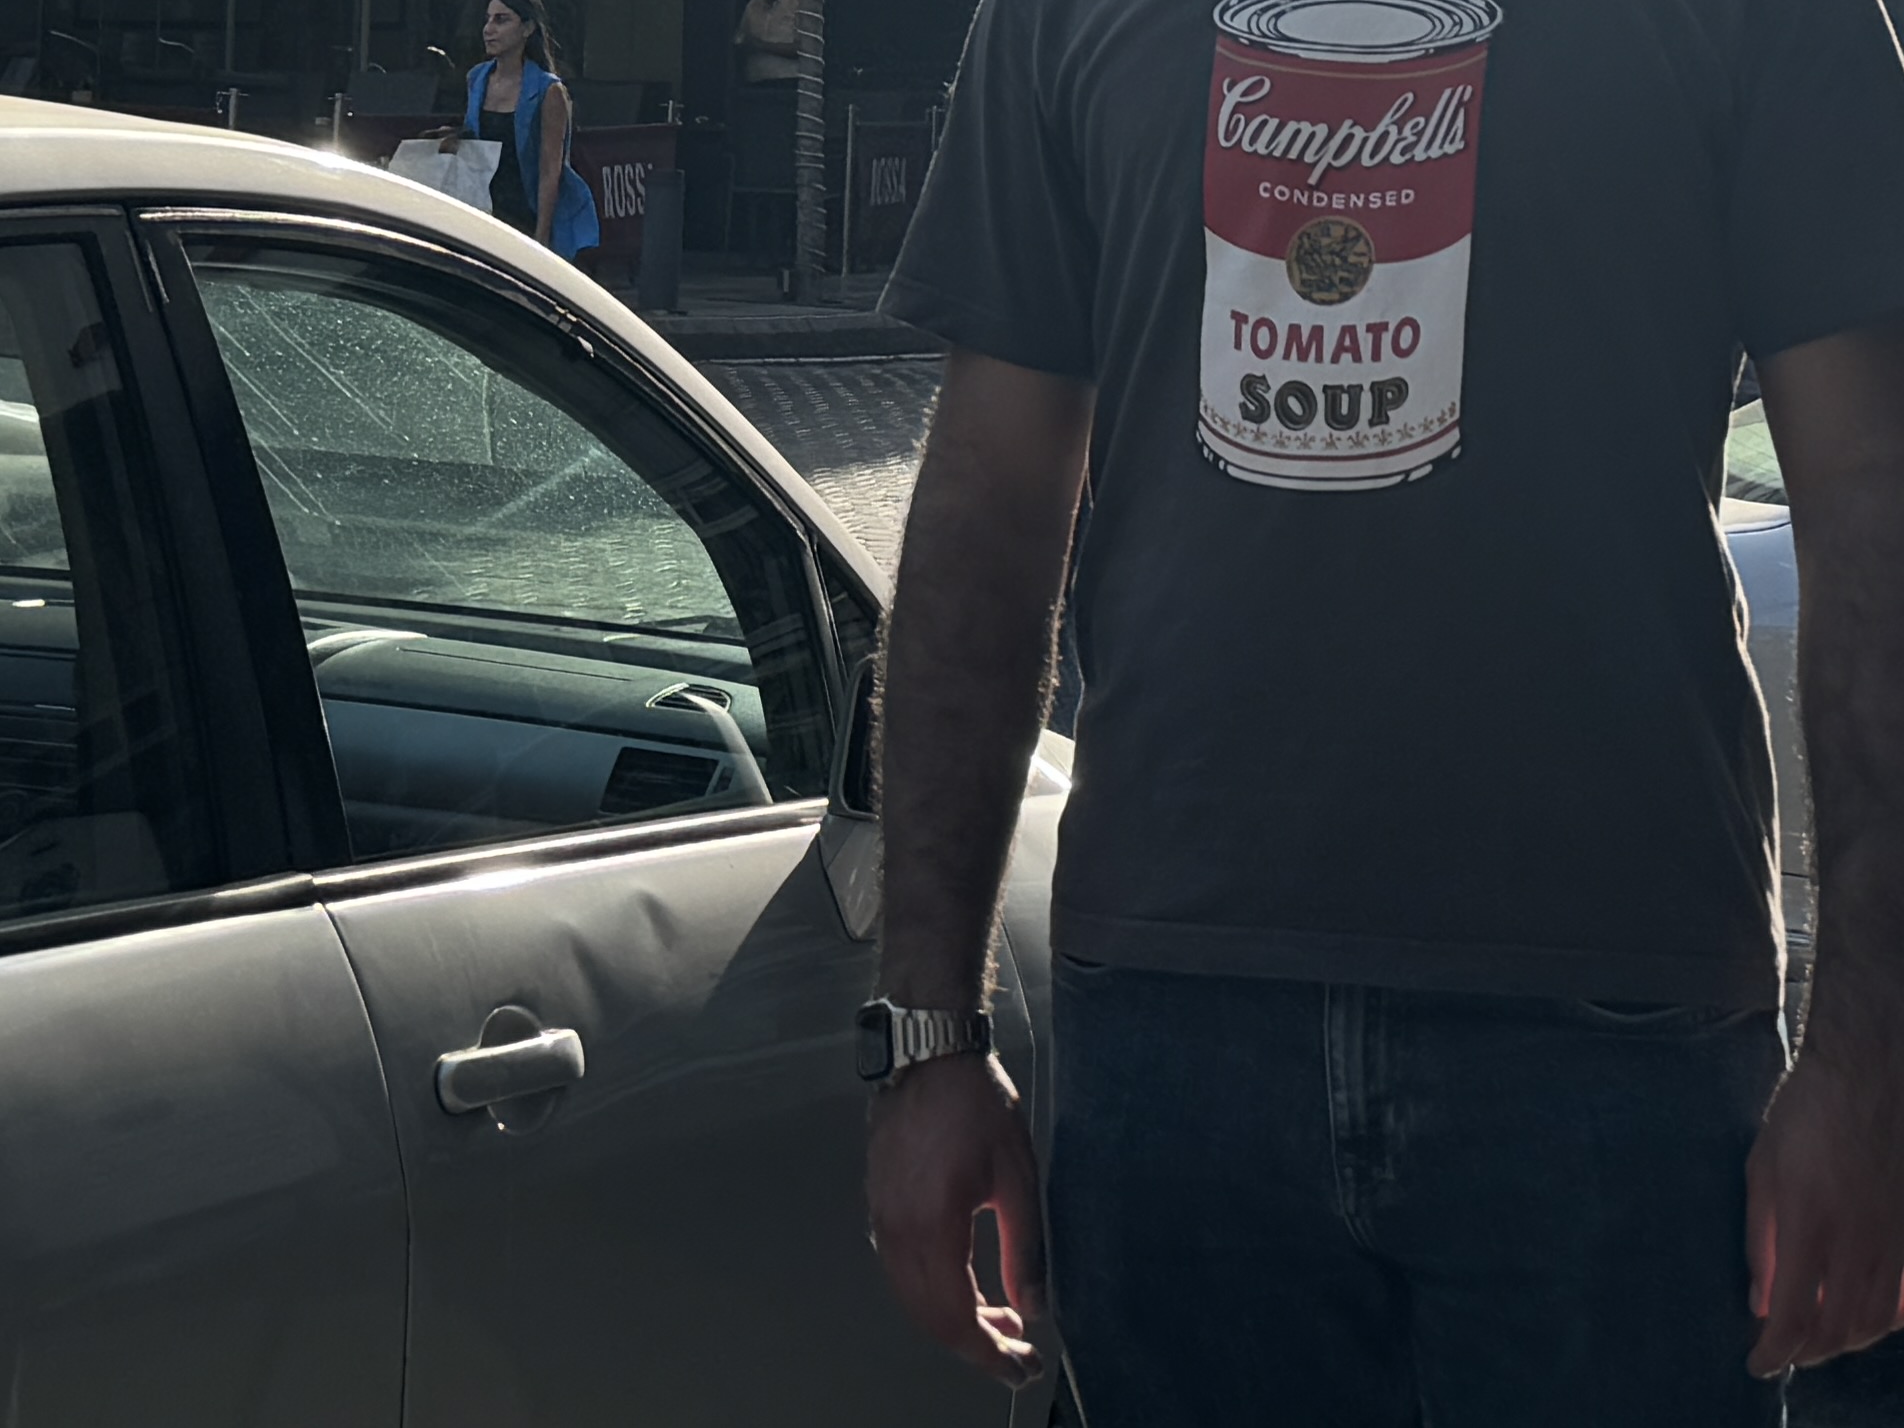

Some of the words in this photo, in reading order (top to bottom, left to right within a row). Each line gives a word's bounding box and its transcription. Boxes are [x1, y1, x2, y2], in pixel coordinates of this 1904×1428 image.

[1216, 74, 1474, 189] Campbell's
[602, 162, 653, 219] ROSS
[1258, 182, 1416, 210] CONDENSED
[1229, 310, 1422, 366] TOMATO
[1238, 374, 1410, 432] SOUP
